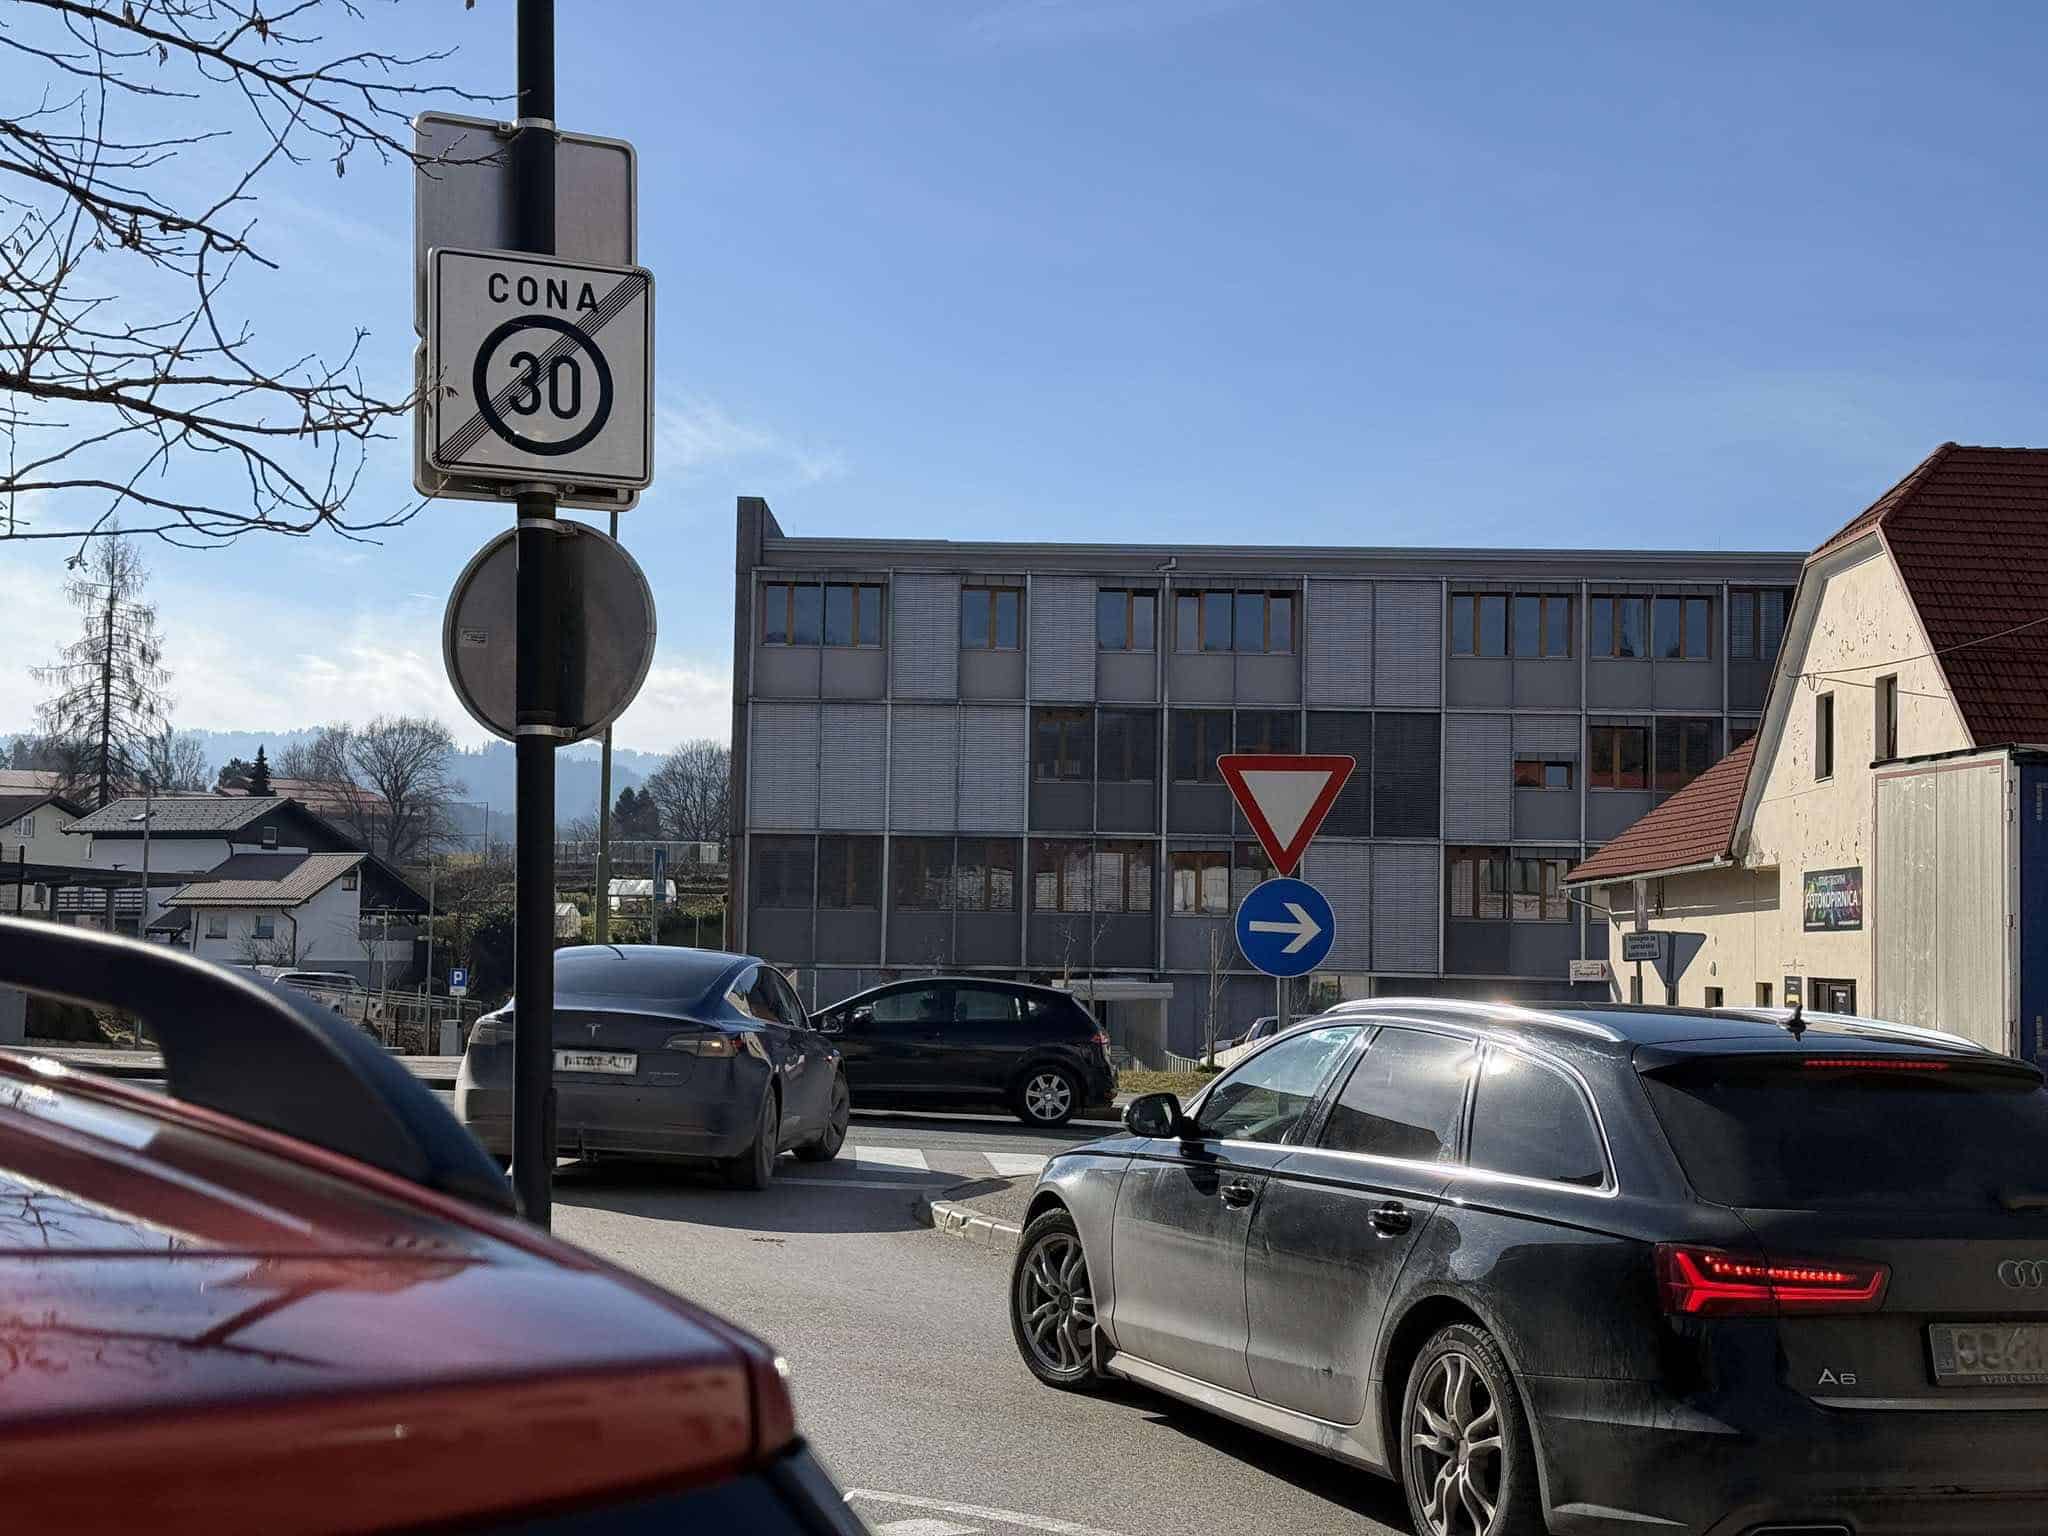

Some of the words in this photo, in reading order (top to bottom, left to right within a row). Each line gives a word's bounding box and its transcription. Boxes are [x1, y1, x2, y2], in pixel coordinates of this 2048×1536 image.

[488, 272, 599, 313] CONA
[509, 351, 581, 419] 30
[453, 971, 463, 984] P
[1817, 1368, 1857, 1385] A6
